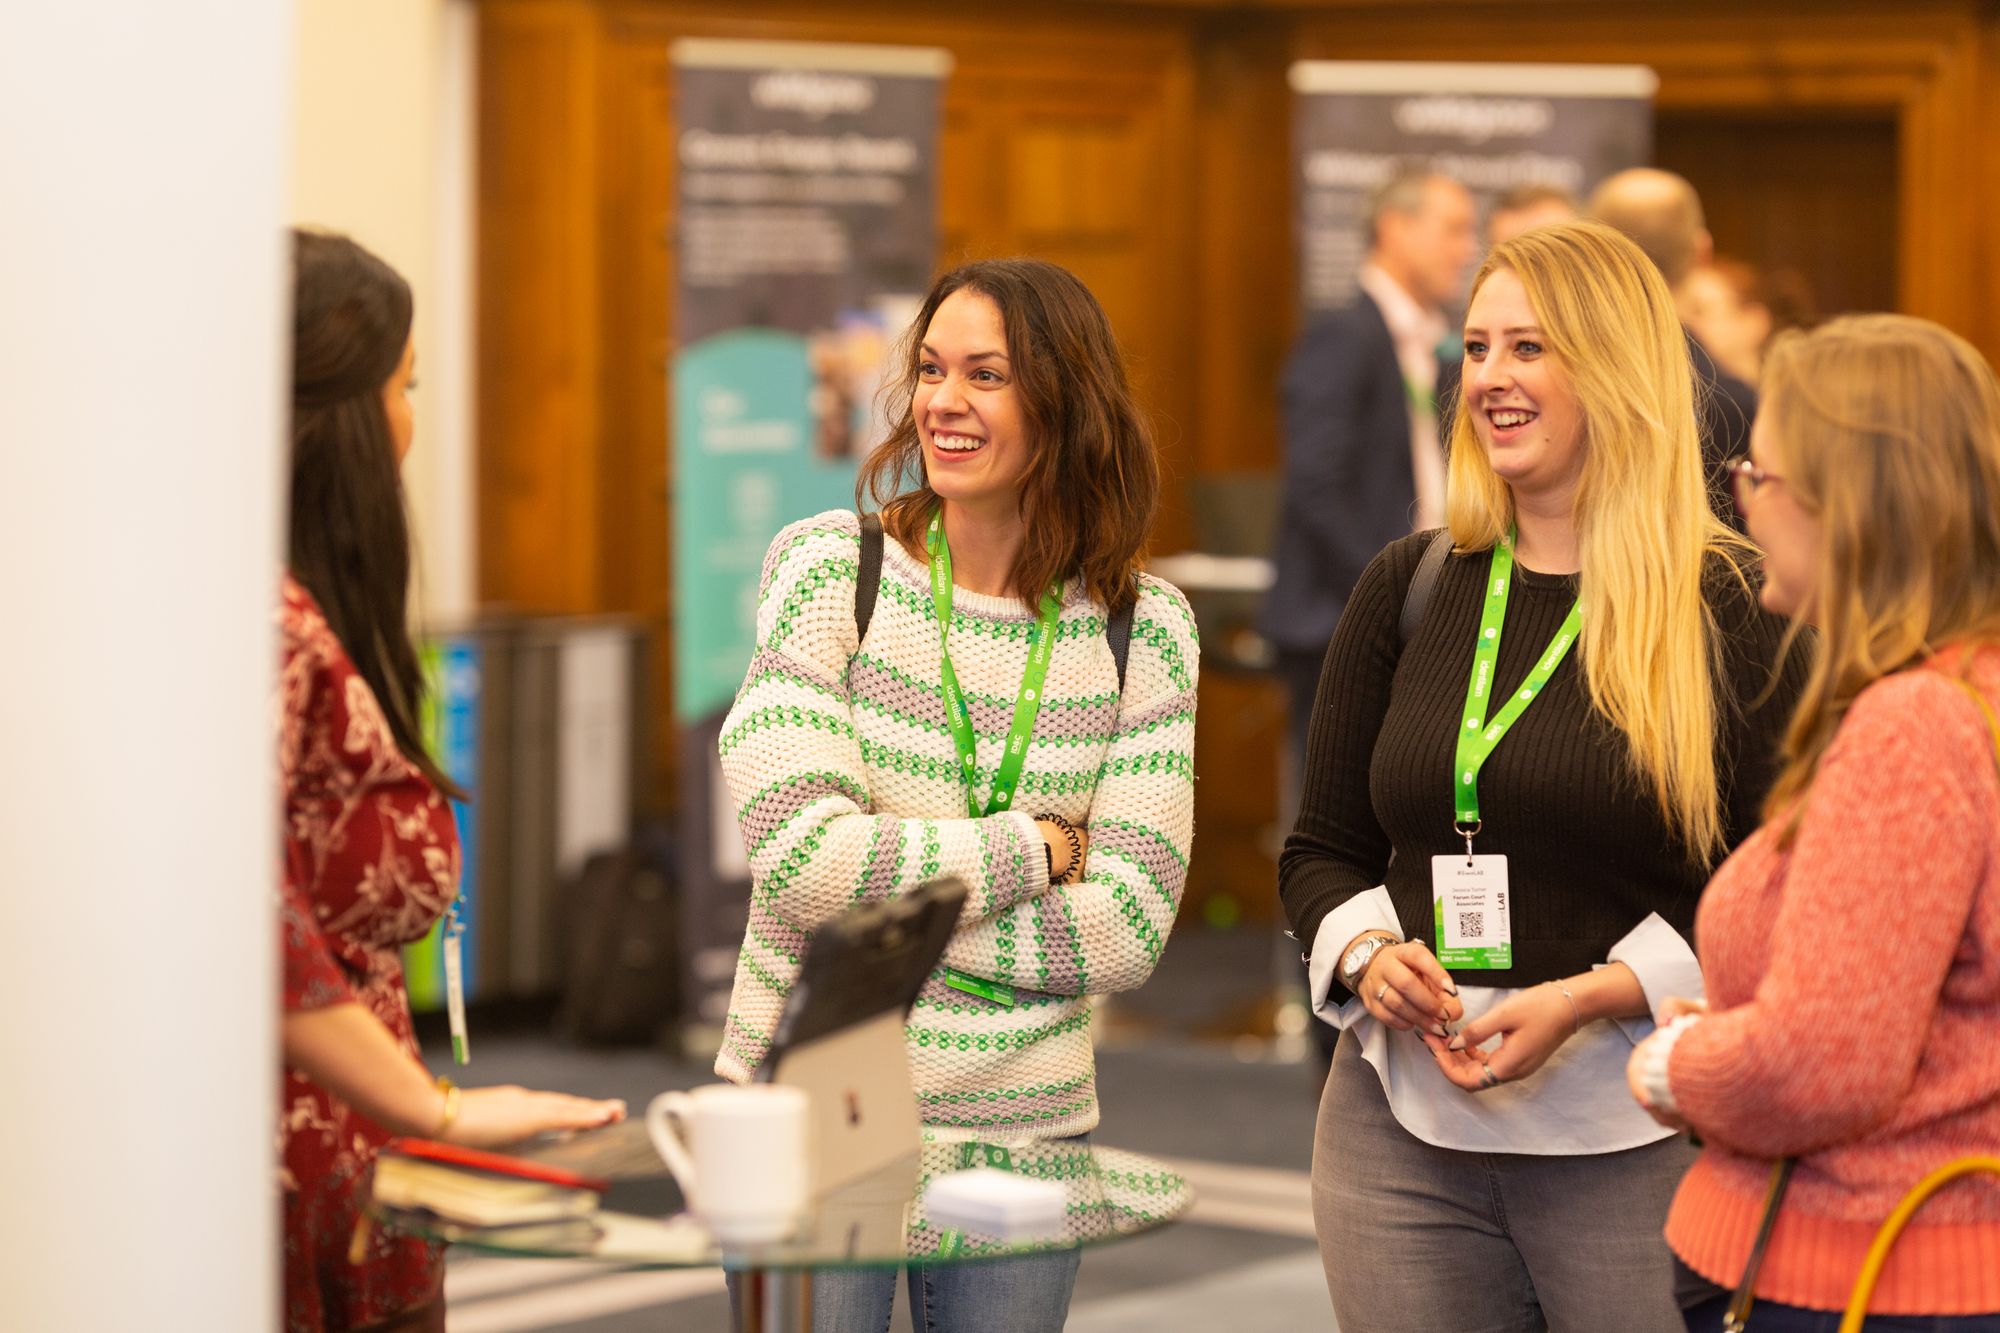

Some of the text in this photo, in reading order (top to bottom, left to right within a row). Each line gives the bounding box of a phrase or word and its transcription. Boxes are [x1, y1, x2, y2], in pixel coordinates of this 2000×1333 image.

[1032, 621, 1051, 665] identilam
[945, 684, 964, 729] identilam
[1010, 734, 1024, 755] ID&C
